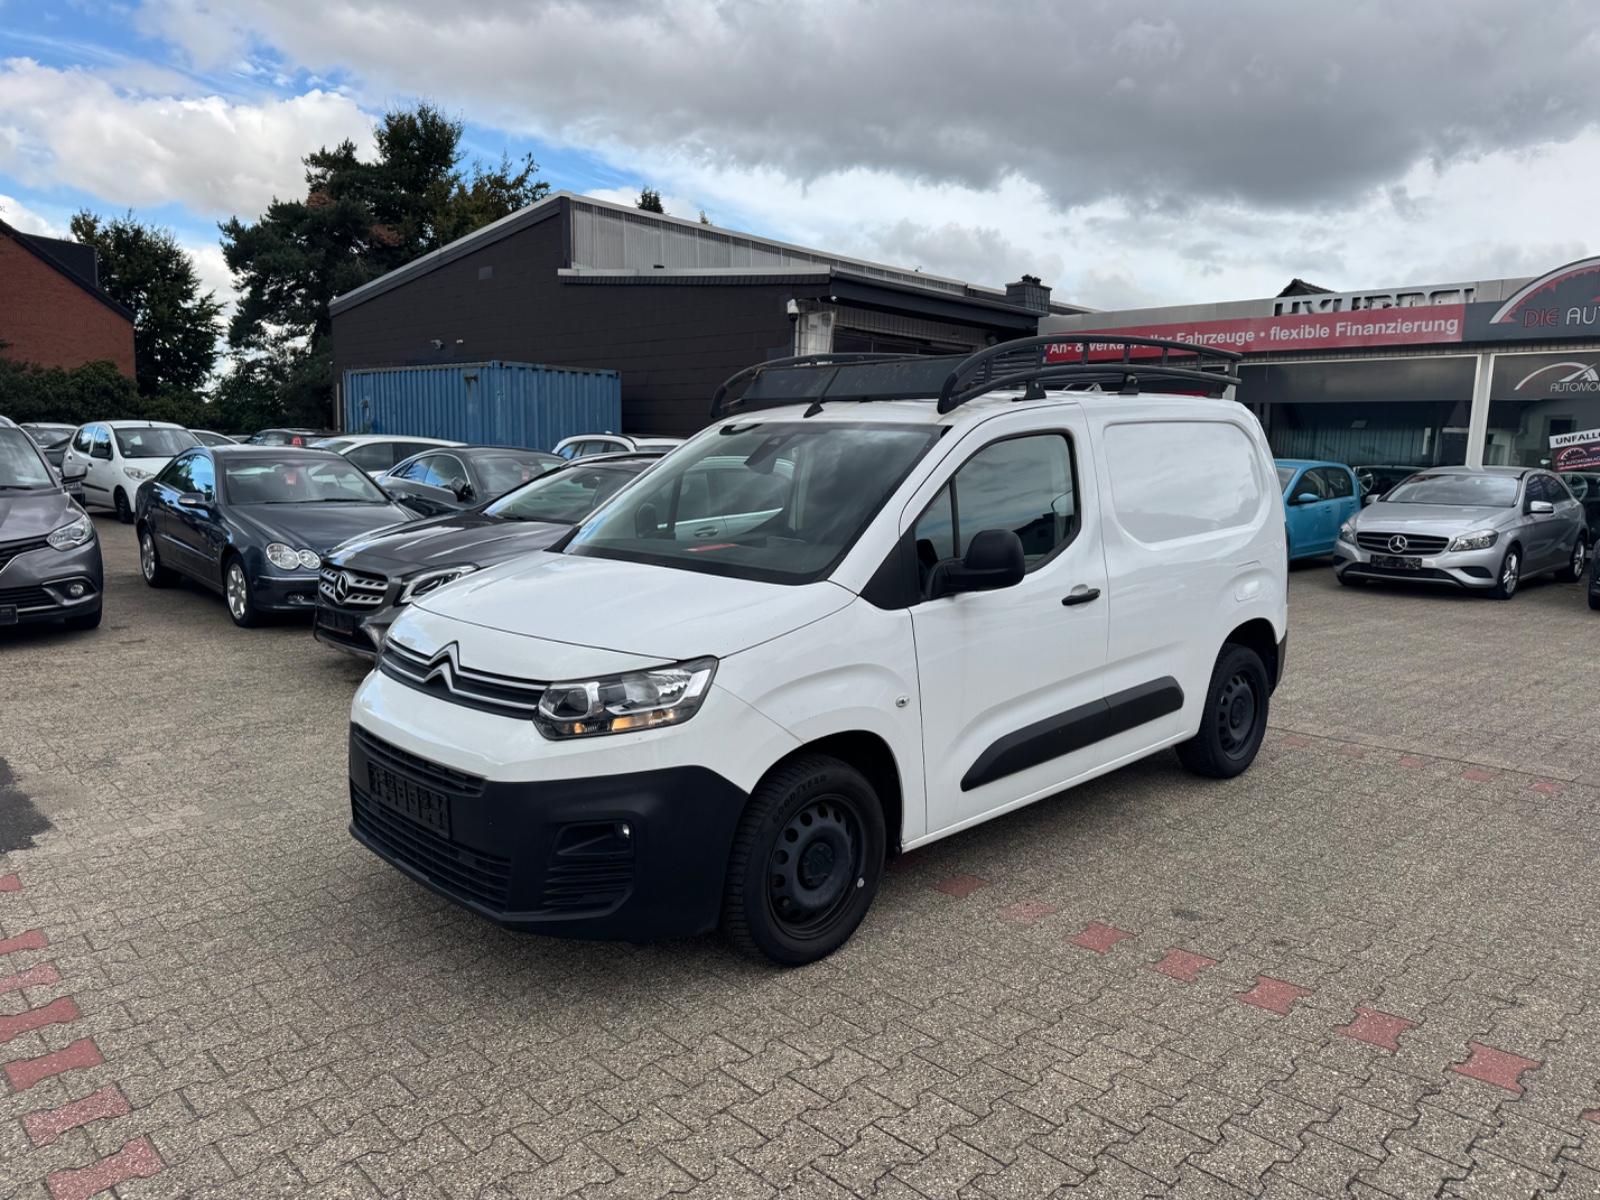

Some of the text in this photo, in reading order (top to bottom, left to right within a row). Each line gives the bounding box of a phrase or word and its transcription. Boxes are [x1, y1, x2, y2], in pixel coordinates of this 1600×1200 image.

[1524, 305, 1600, 328] DIE AU
[1176, 331, 1255, 346] Fahrzeuge
[1270, 324, 1330, 341] flexible
[1335, 318, 1459, 337] Finanzierung
[1550, 381, 1600, 393] AUTOMO
[1555, 431, 1600, 445] UNFALL
